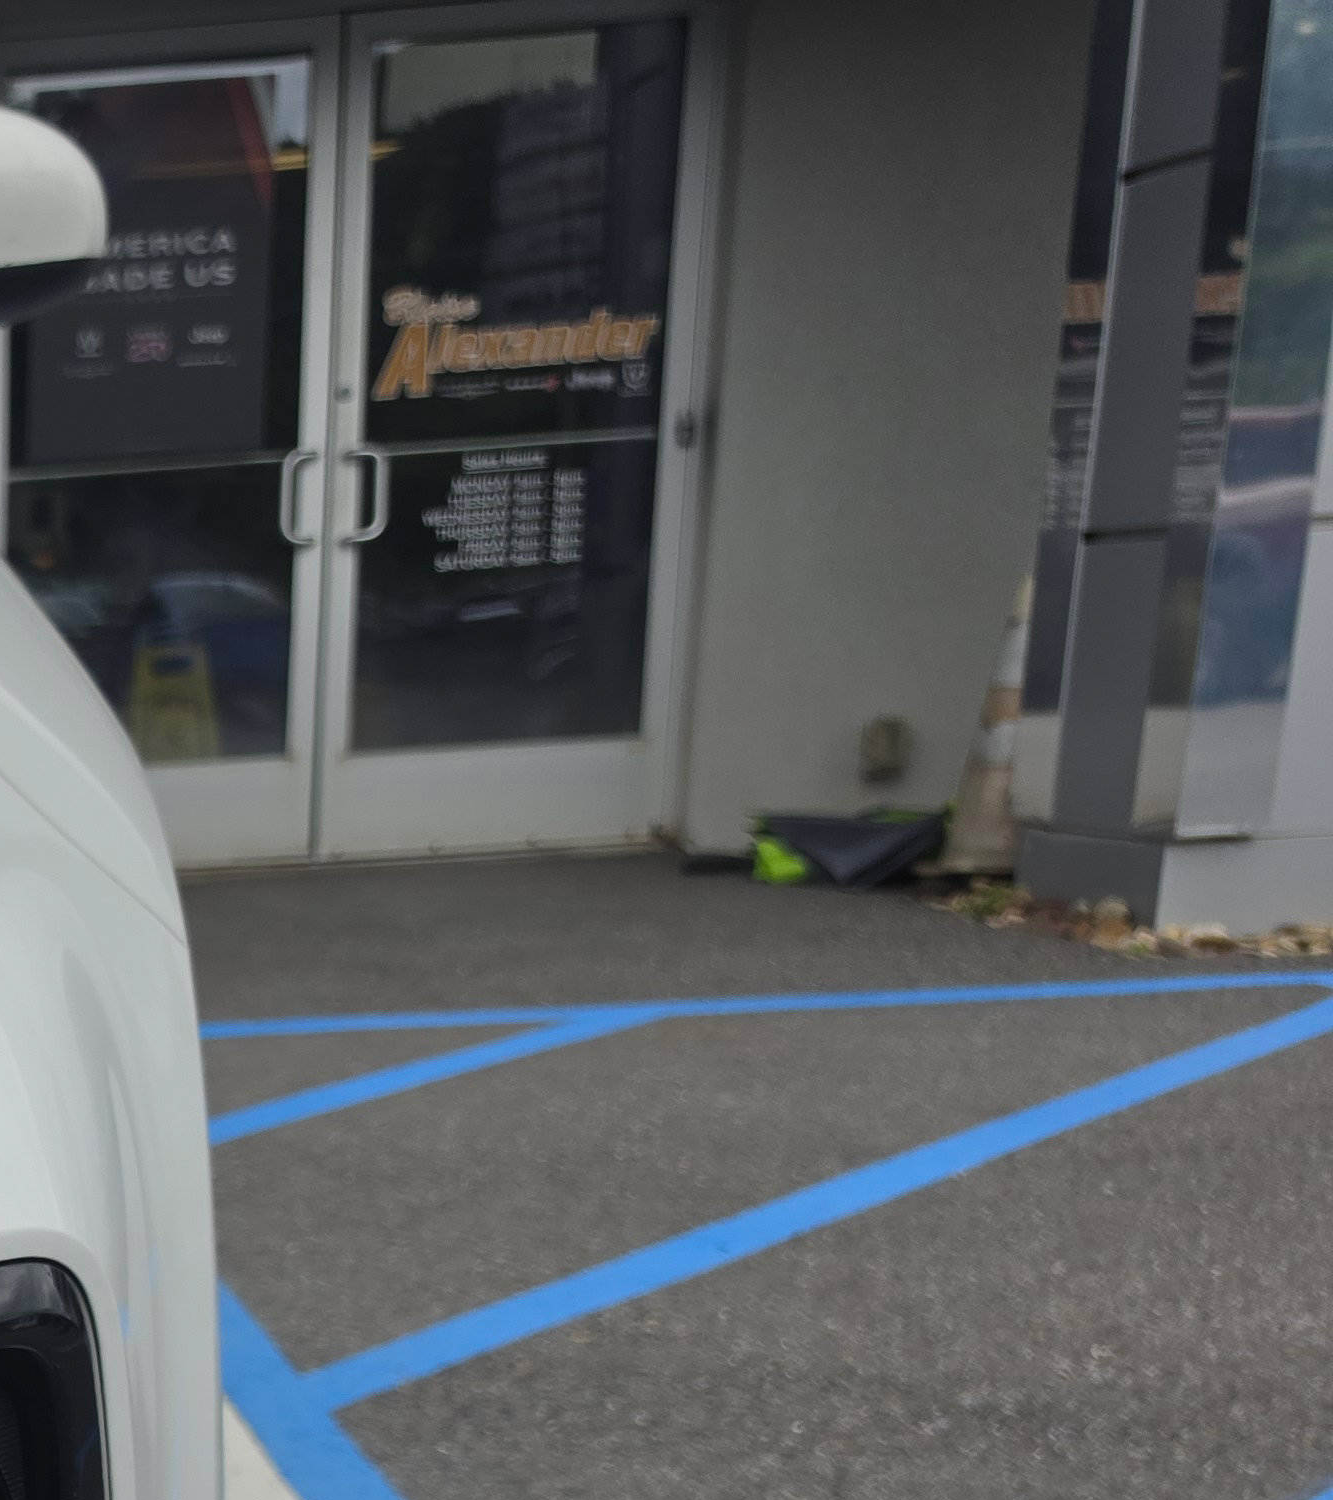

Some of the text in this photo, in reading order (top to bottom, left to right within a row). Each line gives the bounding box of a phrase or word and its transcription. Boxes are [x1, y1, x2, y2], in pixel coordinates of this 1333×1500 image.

[108, 227, 236, 259] MERICA
[183, 257, 237, 288] US
[371, 306, 660, 401] Alexander
